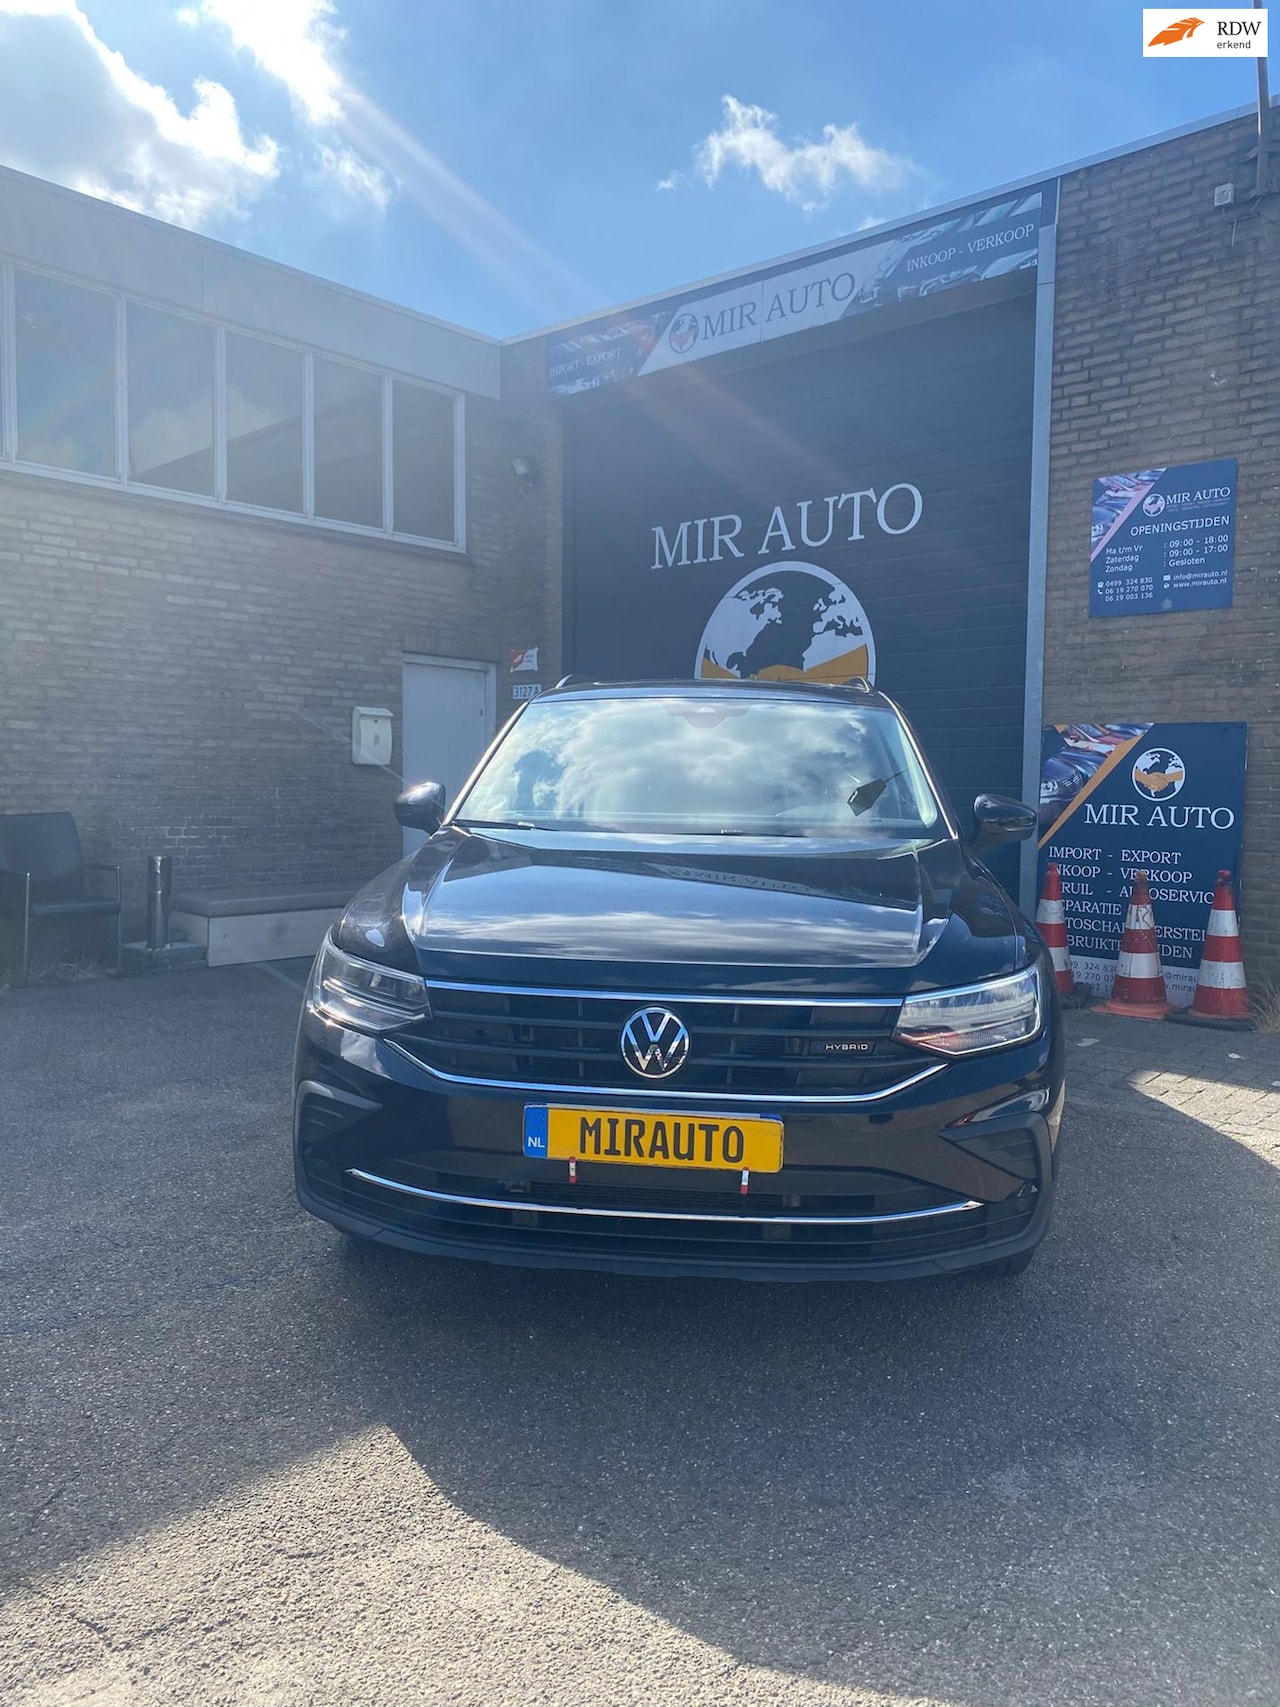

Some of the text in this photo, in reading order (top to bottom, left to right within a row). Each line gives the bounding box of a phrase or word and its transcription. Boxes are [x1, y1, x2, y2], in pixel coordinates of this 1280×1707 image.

[906, 248, 956, 272] INKOOP
[967, 224, 1035, 254] VERKOOP
[702, 273, 855, 341] MIR AUTO
[1166, 487, 1231, 505] MIR AUTO
[651, 483, 923, 569] MIR AUTO
[1130, 515, 1230, 536] OPENINGSTIJDEN
[1169, 538, 1194, 548] 09:00
[1204, 534, 1229, 544] 18:00
[1105, 555, 1140, 564] Zaterdag
[1169, 547, 1194, 558] 09:00
[1204, 544, 1229, 554] 17:00
[1105, 564, 1133, 573] Zondag
[1168, 557, 1206, 567] Gesloten
[1173, 569, 1228, 581] info@mirauto.nl
[1173, 577, 1227, 588] www.mirauto.nl
[1084, 803, 1235, 830] MIR AUTO
[1049, 846, 1102, 860] IMPORT
[1121, 849, 1181, 864] EXPORT
[1056, 864, 1100, 878] NKOOP
[1061, 882, 1093, 895] RUIL
[1062, 899, 1122, 916] PARATIE
[1084, 962, 1100, 970] 324
[527, 1116, 744, 1164] NL MIRAUTO
